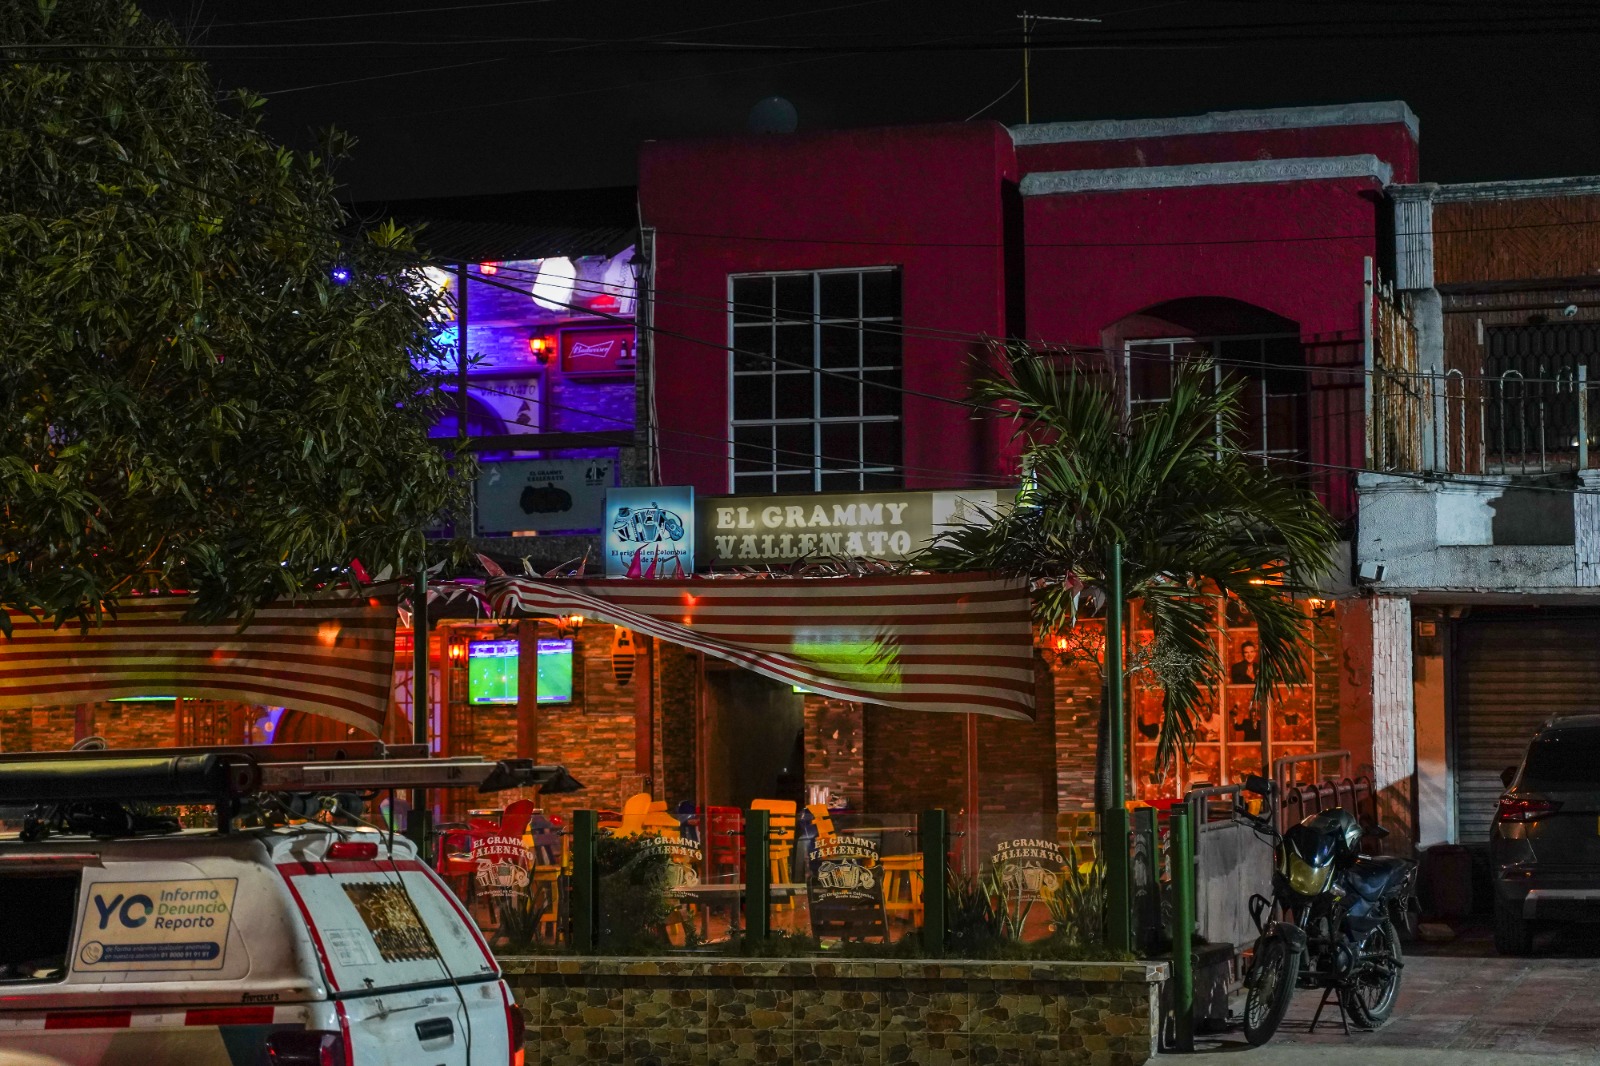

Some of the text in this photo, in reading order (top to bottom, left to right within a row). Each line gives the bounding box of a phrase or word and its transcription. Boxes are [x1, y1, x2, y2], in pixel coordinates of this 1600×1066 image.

[716, 502, 909, 529] EL GRAMMY
[714, 530, 911, 559] VALLENATO
[473, 838, 486, 848] EL
[640, 836, 700, 850] EL GRAMMY
[814, 836, 877, 850] EL GRAMMY
[997, 838, 1060, 852] EL GRAMMY
[809, 845, 879, 861] VALLENATO
[992, 847, 1063, 864] VALLENATO
[160, 887, 219, 902] Informo
[94, 893, 154, 930] YO
[157, 901, 227, 916] Denuncio
[154, 915, 215, 931] Reporto
